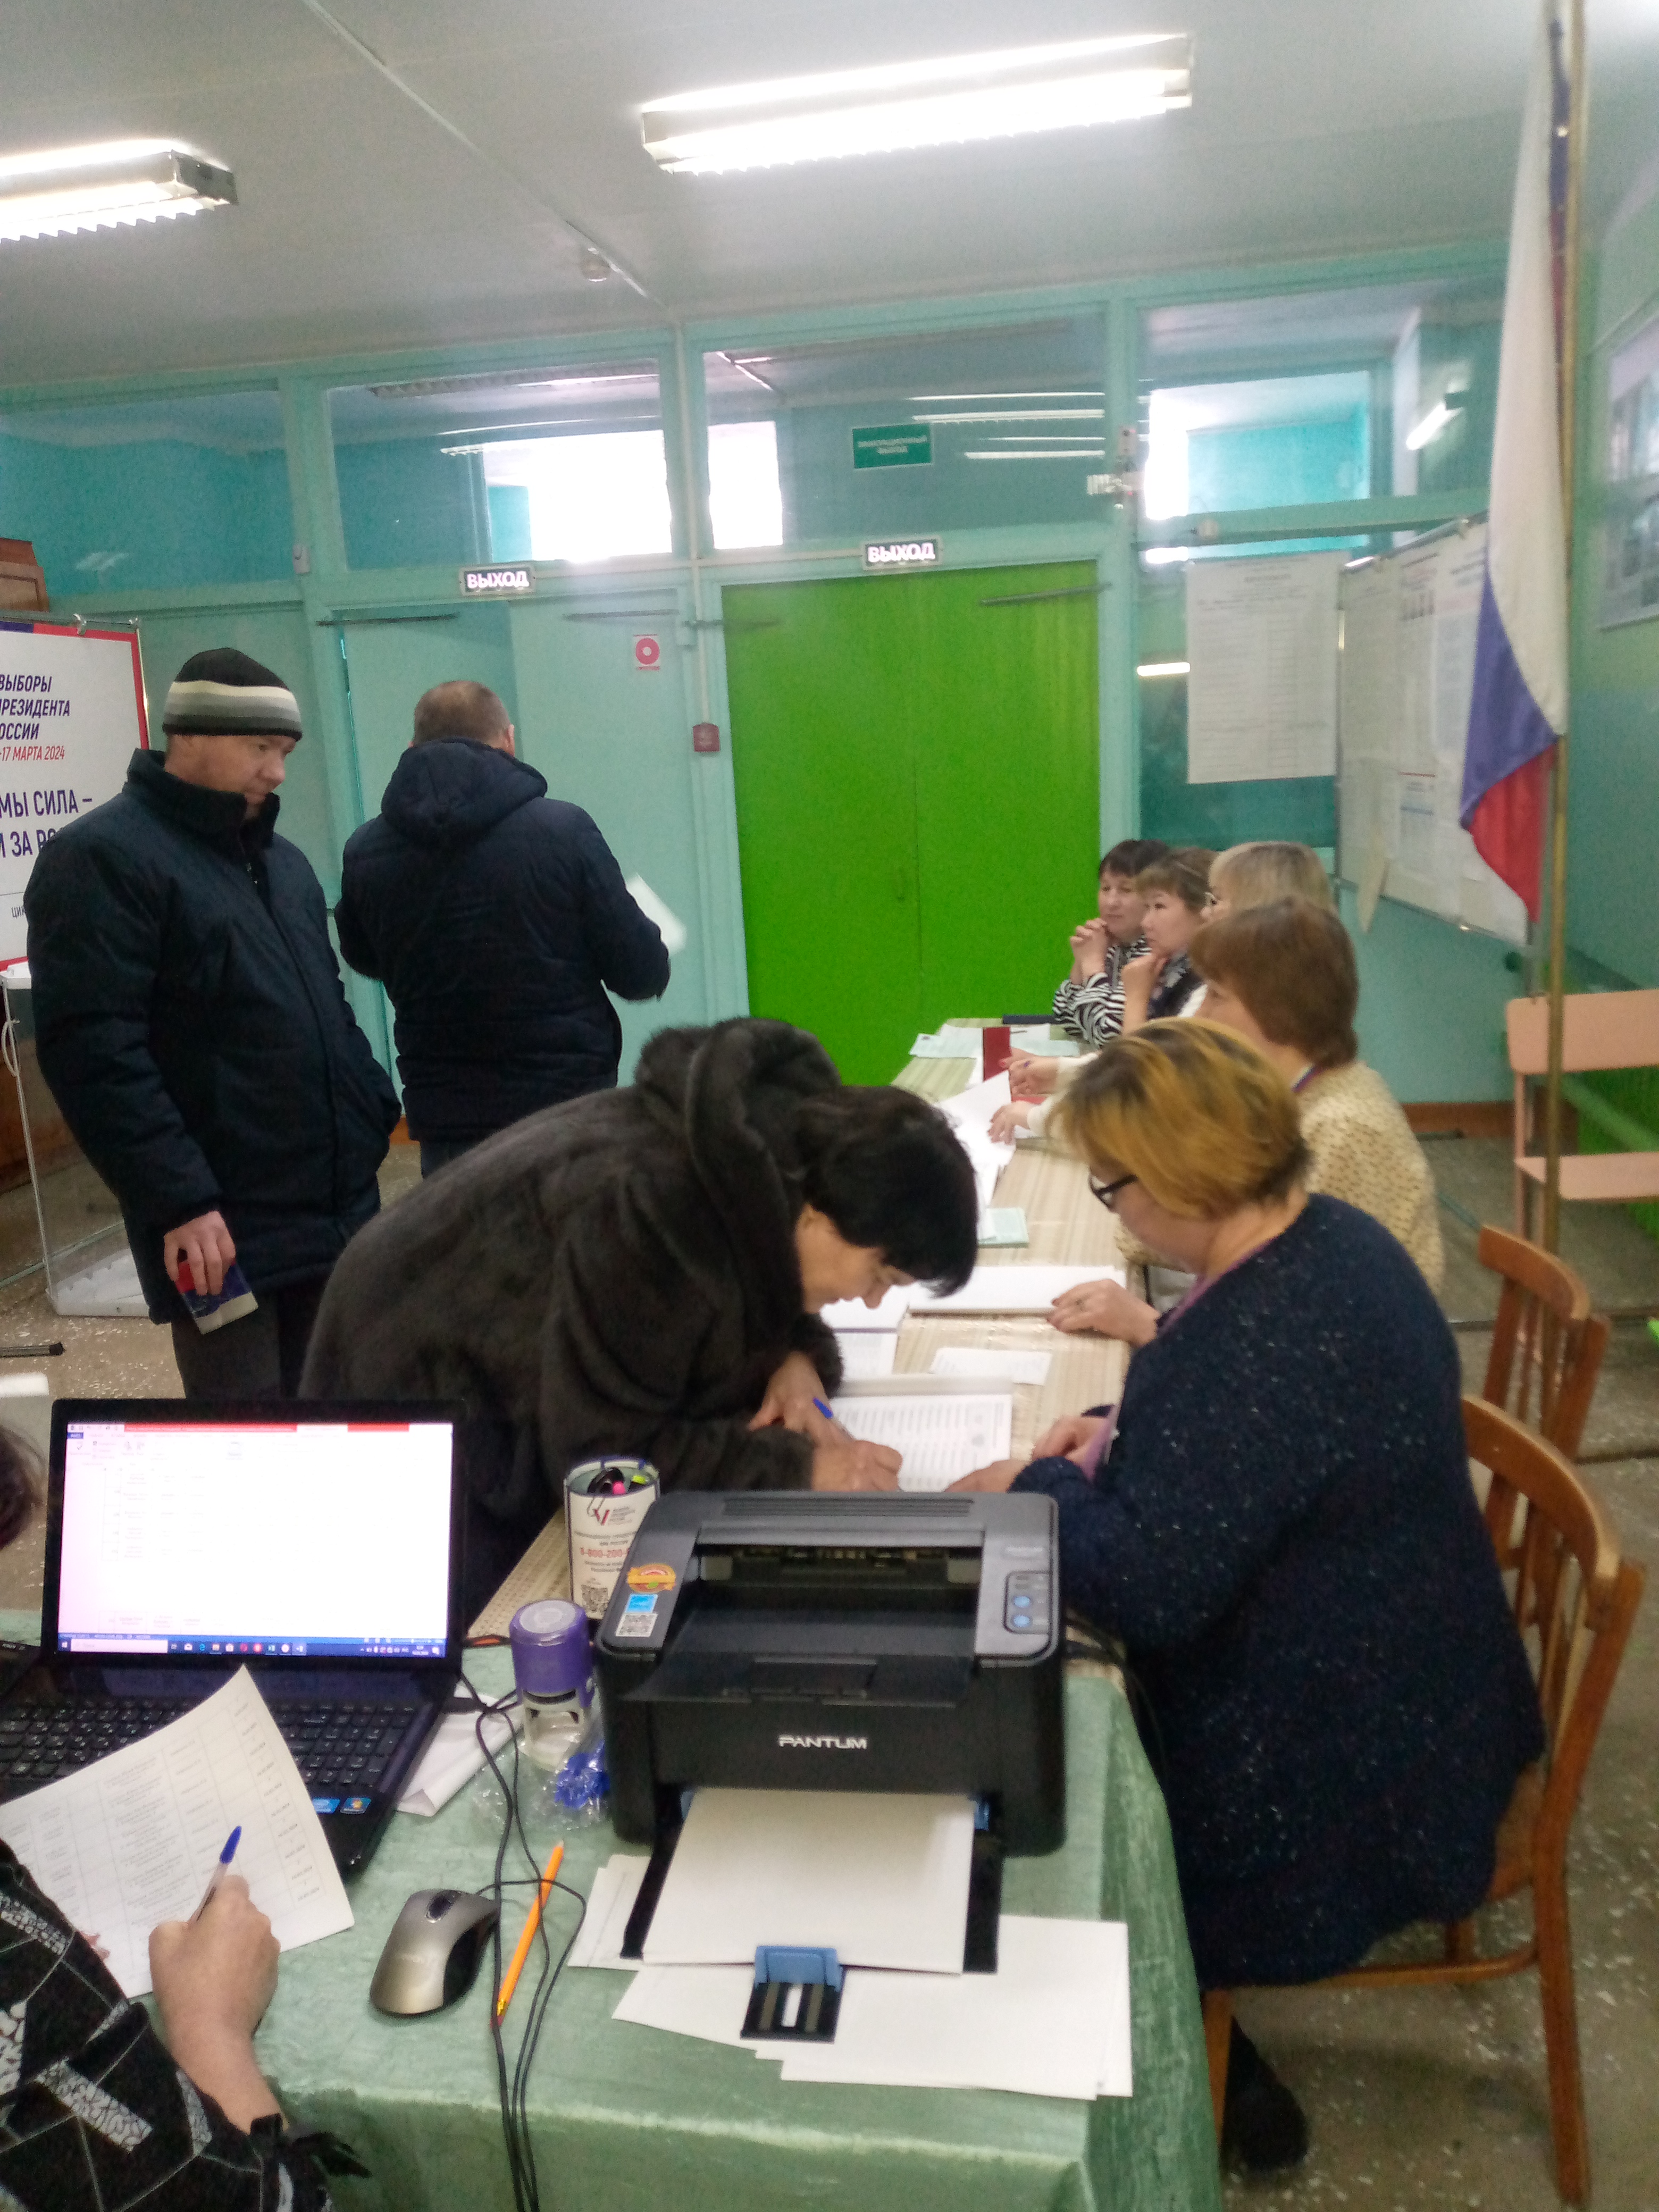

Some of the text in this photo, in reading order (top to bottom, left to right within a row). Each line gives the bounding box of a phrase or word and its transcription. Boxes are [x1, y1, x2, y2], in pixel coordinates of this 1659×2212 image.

[868, 542, 936, 563] ВЫХОД
[467, 571, 530, 588] ВЫХОД
[0, 674, 52, 692] ВЫБОРЫ
[0, 723, 39, 740] ОССИИ
[12, 746, 42, 761] МАРТА
[44, 745, 65, 760] 2024
[0, 792, 29, 818] МЫ
[33, 790, 79, 816] СИЛА
[10, 831, 33, 857] ЗА
[779, 1736, 867, 1749] PANTUM
